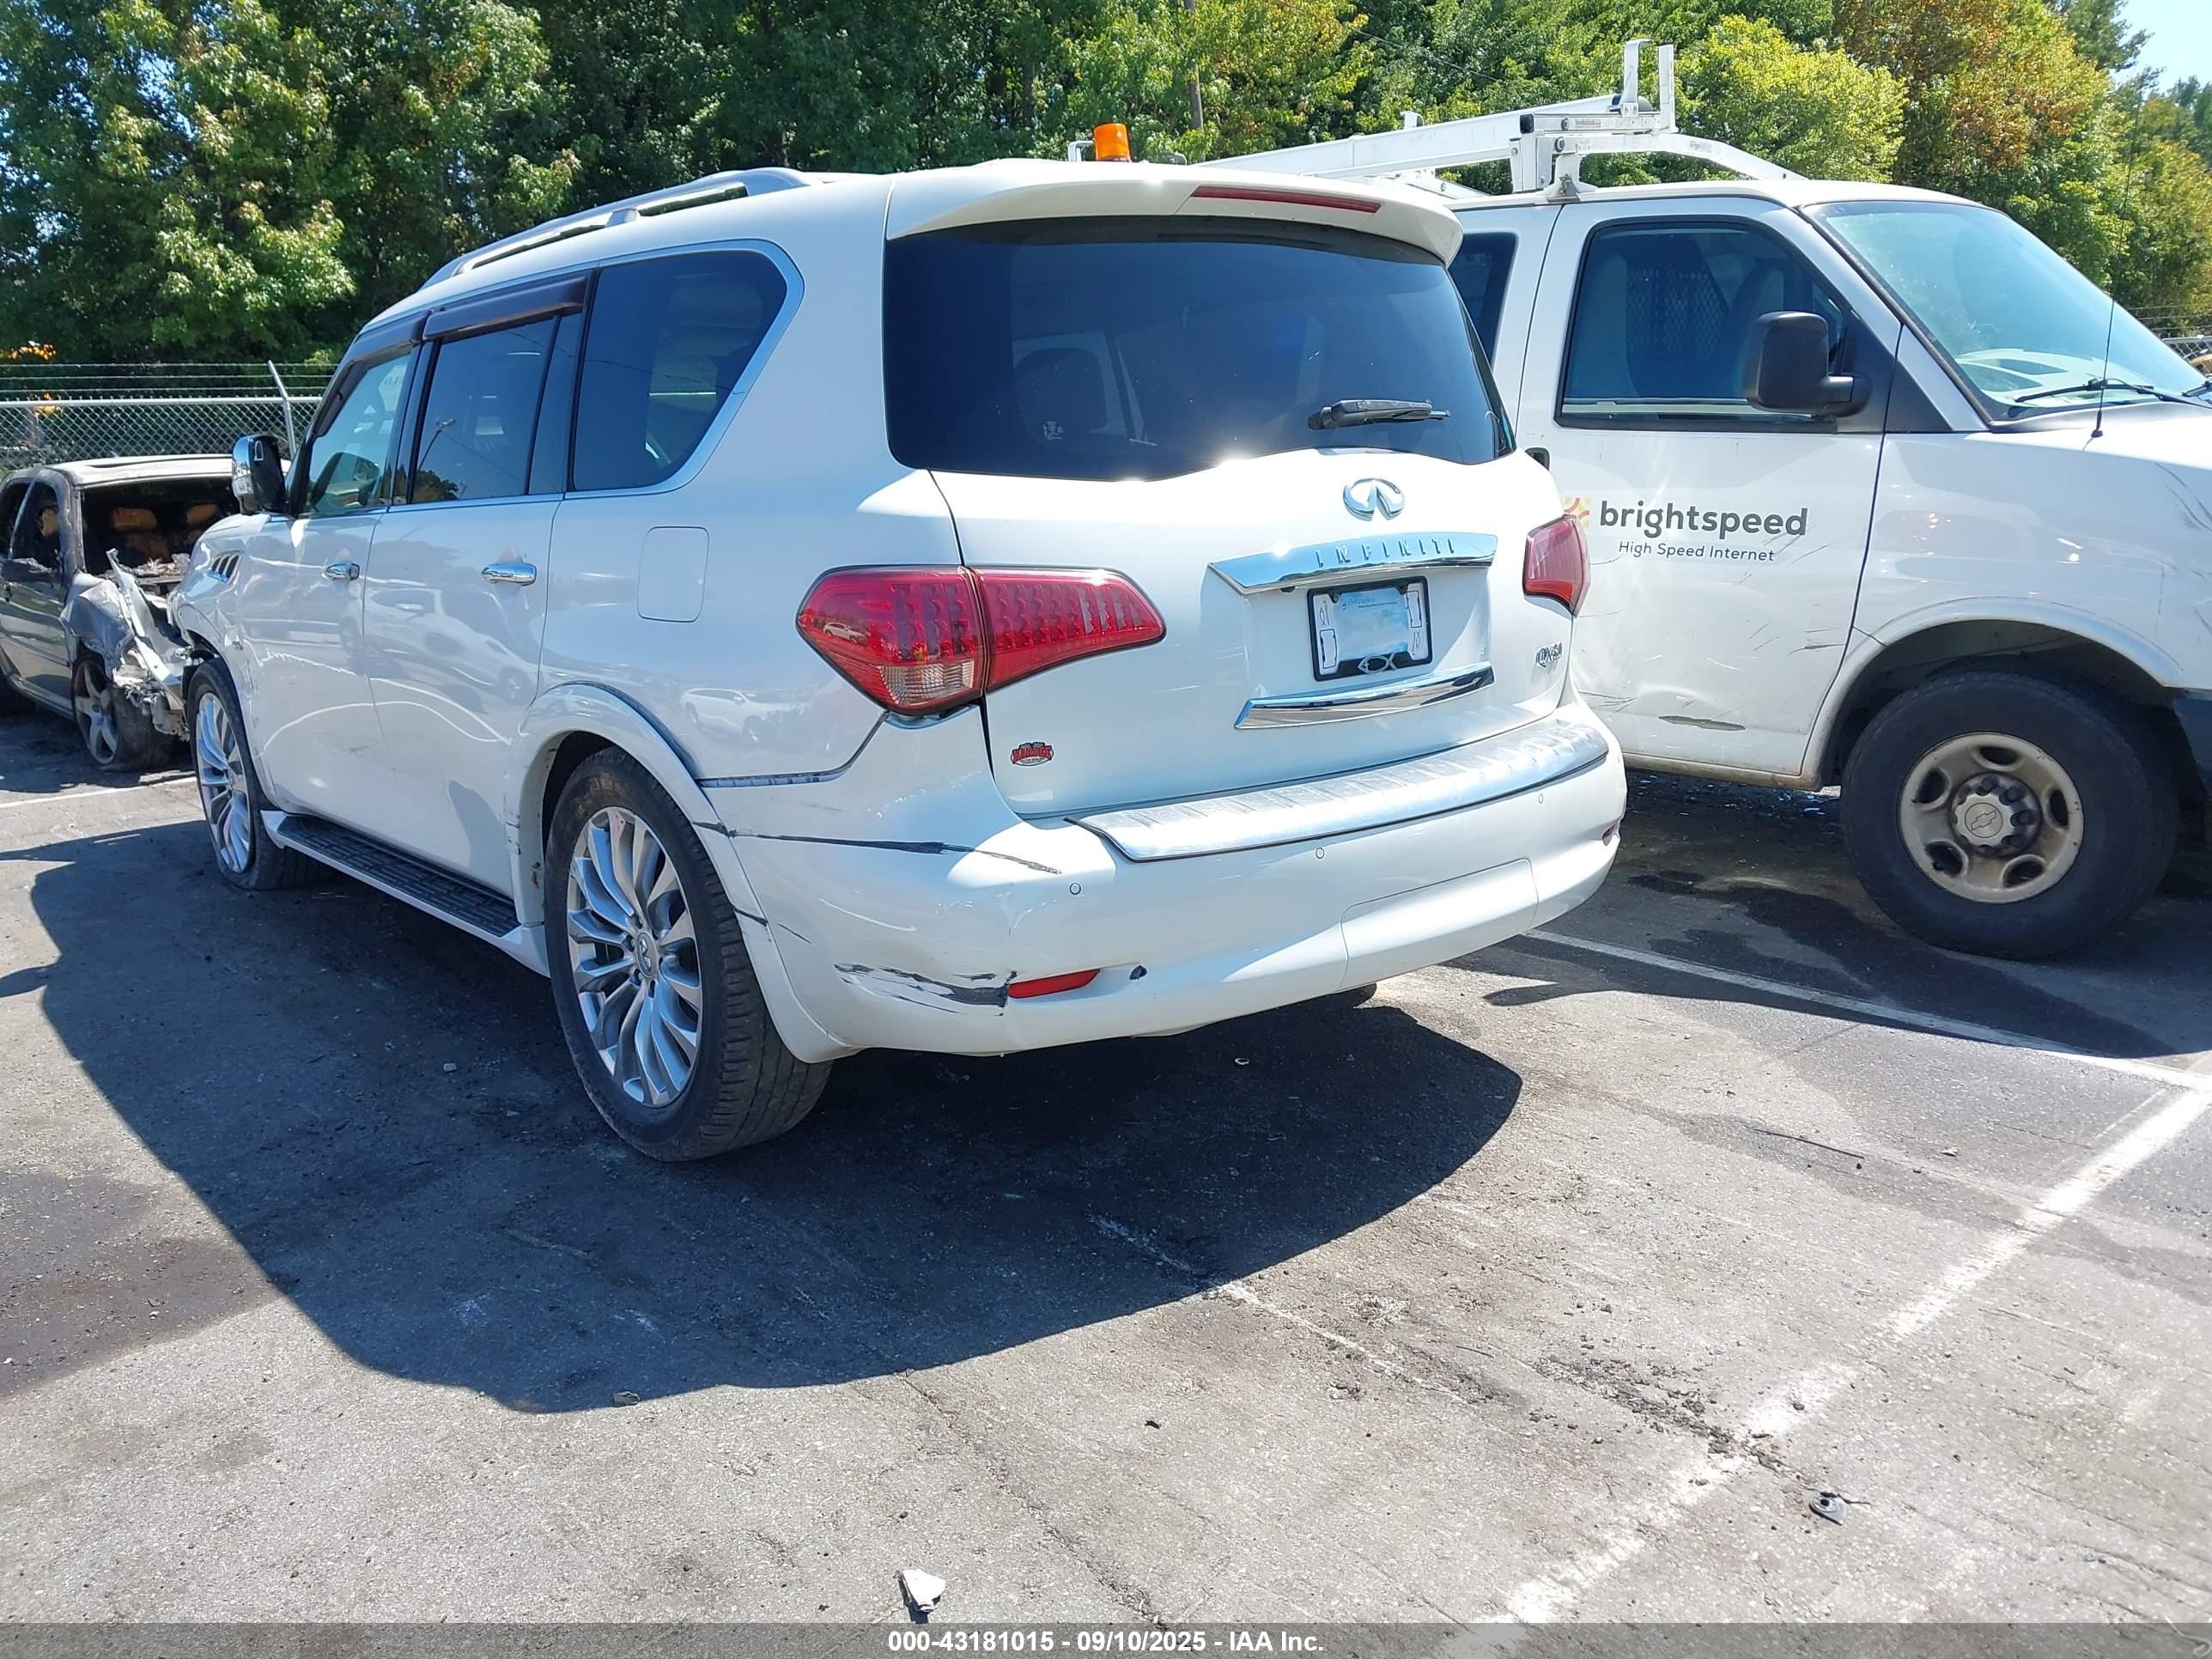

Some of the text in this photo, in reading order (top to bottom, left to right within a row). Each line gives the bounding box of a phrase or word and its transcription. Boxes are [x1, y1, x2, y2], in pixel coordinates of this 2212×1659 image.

[1600, 500, 1808, 539] brightspeed
[1315, 538, 1455, 568] INFINITI
[1619, 541, 1776, 562] High Speed Internet
